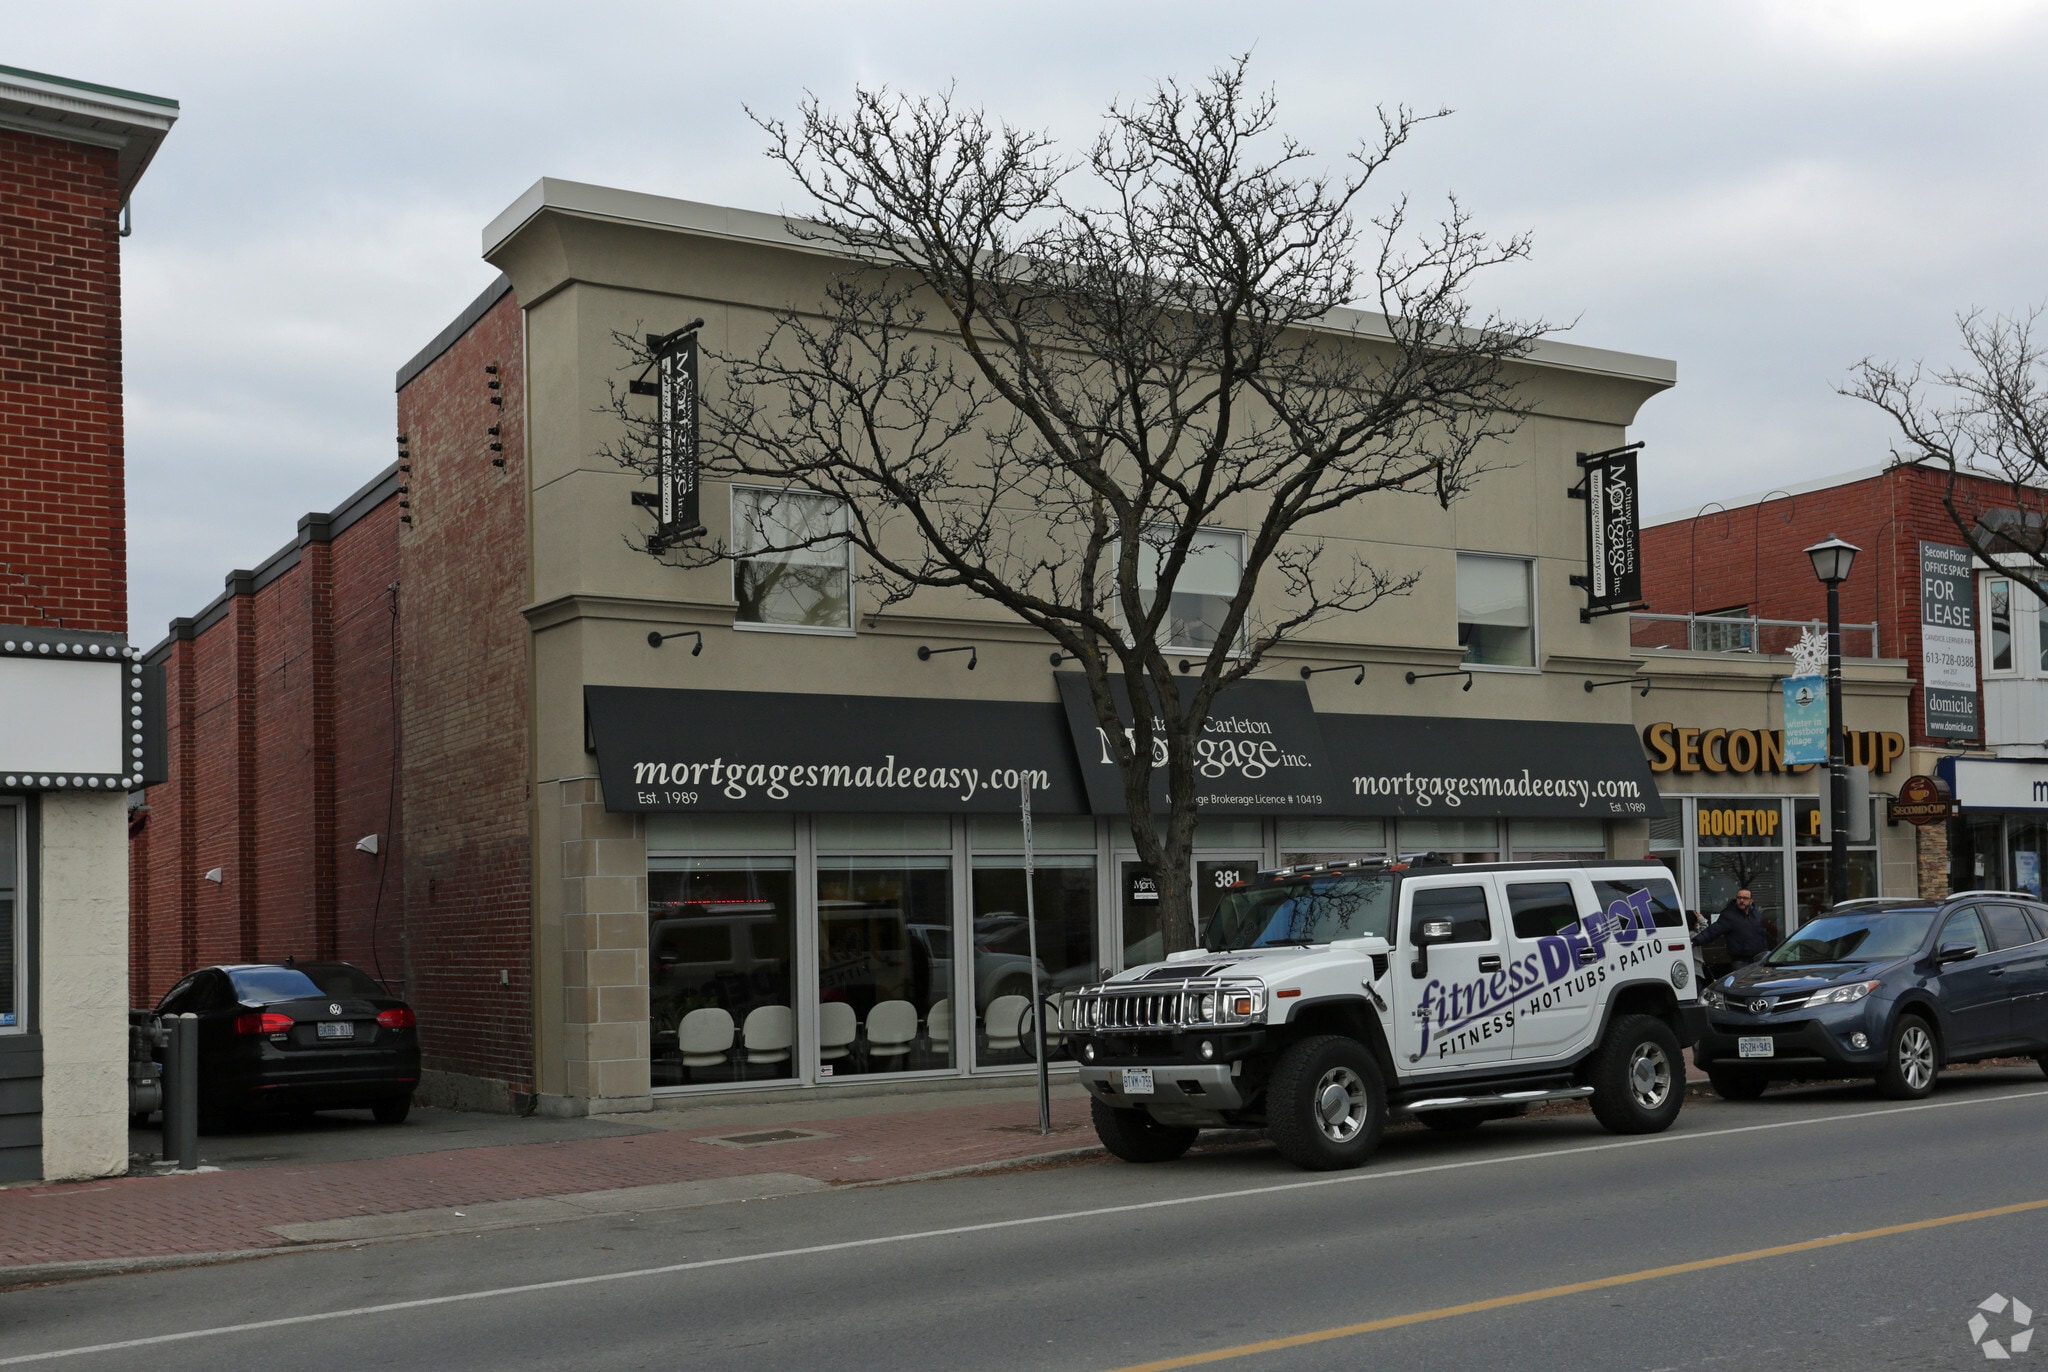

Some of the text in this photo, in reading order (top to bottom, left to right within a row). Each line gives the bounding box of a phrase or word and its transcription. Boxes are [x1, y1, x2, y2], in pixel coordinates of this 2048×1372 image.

[1592, 474, 1603, 592] mortgagesmadeeasy.com
[1605, 464, 1627, 596] Mortgage inc.
[1624, 486, 1634, 574] Ottawa-Carleton
[1925, 545, 1967, 563] Second Floor
[1925, 561, 1970, 578] OFFICE SPACE
[1926, 578, 1954, 601] FOR
[1926, 602, 1971, 627] LEASE
[1930, 693, 1973, 714] domicile
[1787, 720, 1811, 729] winter
[1787, 727, 1825, 737] westboro
[1930, 721, 1974, 732] www.domicile.ca
[1651, 722, 1905, 774] SECON UP
[1787, 737, 1812, 747] village
[1281, 750, 1312, 767] inc.
[633, 755, 1051, 802] mortgagesmadeeasy.com
[1352, 769, 1641, 808] mortgagesmadeeasy.com
[638, 791, 698, 805] Est. 1989
[1211, 794, 1254, 806] Brokerage
[1255, 794, 1286, 804] Licence
[1296, 794, 1323, 805] 10419
[1609, 802, 1646, 813] Est. 1989
[1698, 809, 1779, 837] ROOFTOP
[1215, 870, 1240, 888] 381
[1409, 887, 1658, 1063] fitness DEPOT
[1439, 1010, 1515, 1059] FITNESS
[1620, 938, 1663, 971] PATIO
